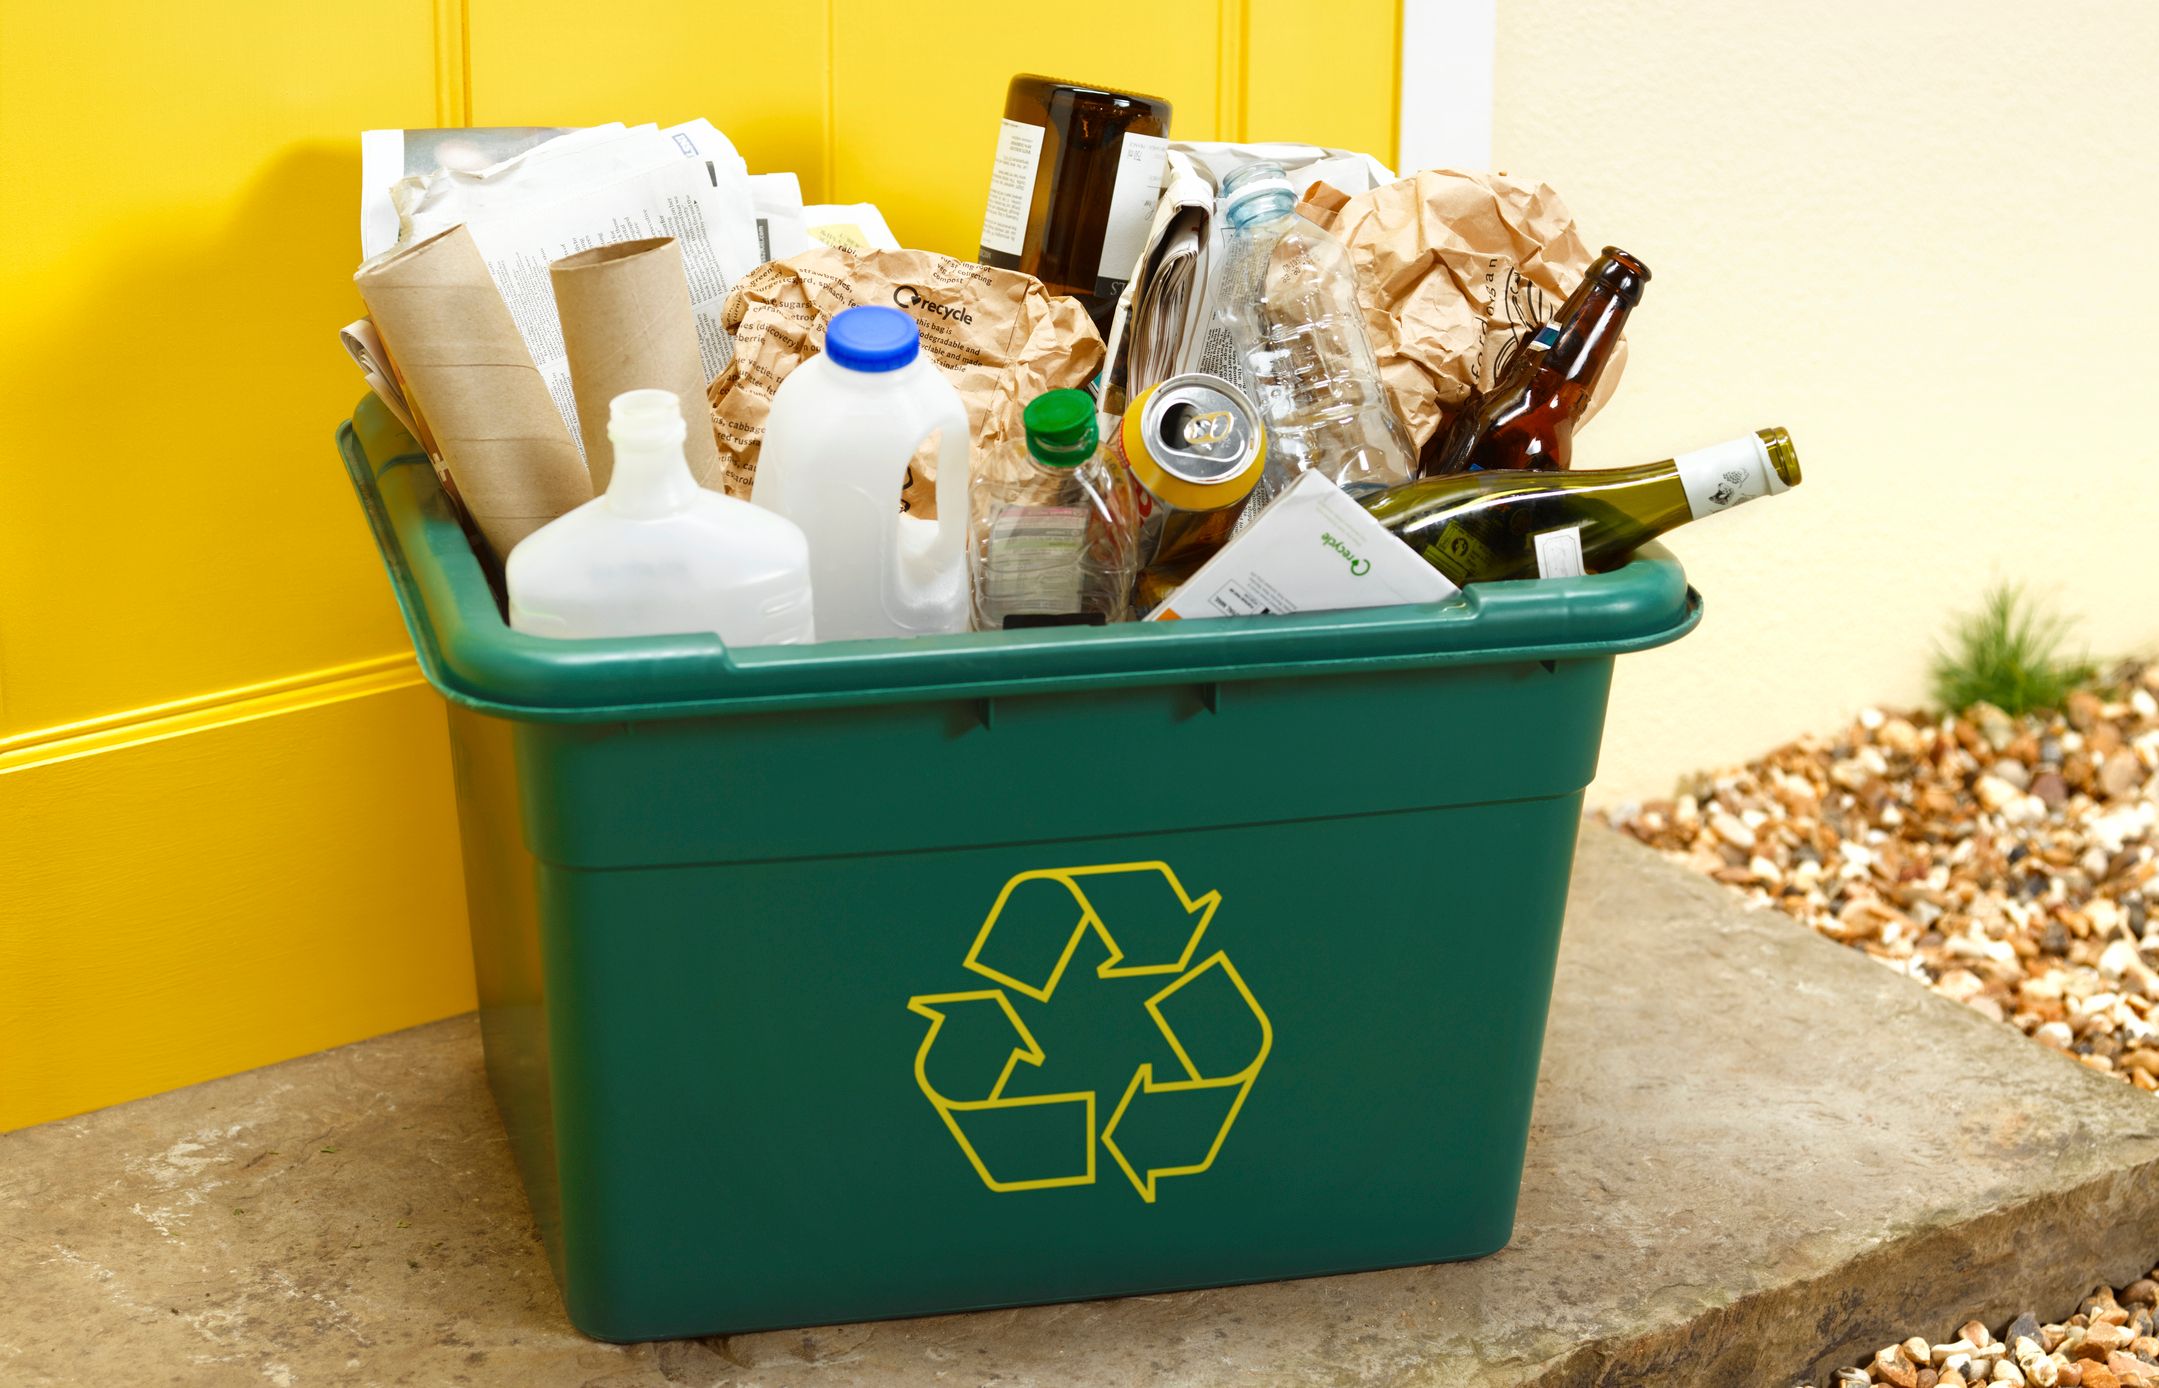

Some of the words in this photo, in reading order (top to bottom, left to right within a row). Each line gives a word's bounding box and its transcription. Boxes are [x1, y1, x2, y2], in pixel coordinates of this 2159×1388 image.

[933, 272, 964, 284] compost
[920, 299, 973, 325] recycle
[916, 318, 930, 328] this
[931, 322, 945, 335] bag
[918, 329, 965, 351] iodegradable
[965, 346, 981, 356] and
[946, 351, 961, 361] and
[962, 357, 983, 368] made
[734, 437, 761, 447] russia
[1321, 532, 1354, 561] recycle
